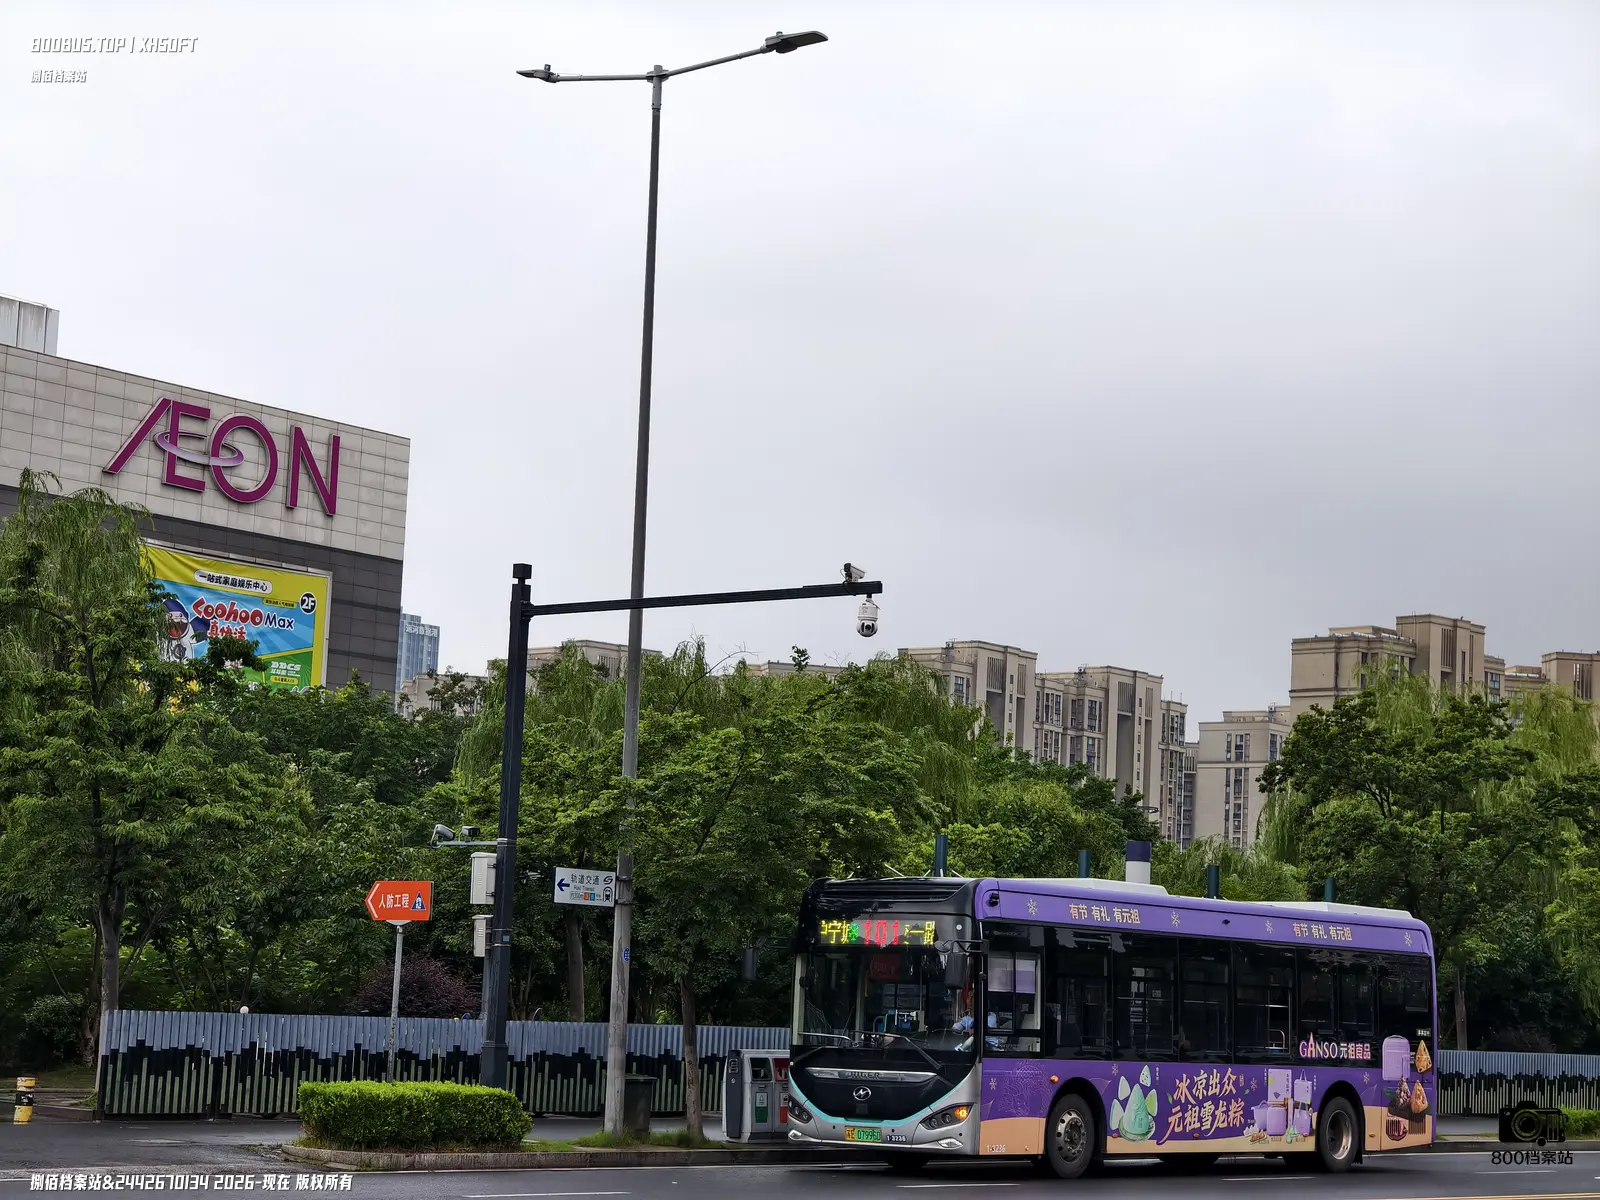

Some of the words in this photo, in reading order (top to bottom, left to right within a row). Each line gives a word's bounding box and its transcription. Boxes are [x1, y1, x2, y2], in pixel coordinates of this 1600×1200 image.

[198, 573, 268, 592] 一站式家庭娱乐中心
[301, 596, 315, 610] 2F
[264, 612, 294, 630] Max
[570, 873, 599, 886] 轨道交通
[378, 893, 409, 909] 人防工程
[1068, 903, 1088, 920] 有节
[1091, 905, 1110, 922] 有礼
[1113, 906, 1141, 924] 有元祖
[863, 919, 900, 945] 101
[1292, 922, 1309, 937] 有节
[1311, 924, 1328, 939] 有礼
[1329, 925, 1353, 941] 有元祖
[1299, 1032, 1338, 1059] GANSO
[1339, 1042, 1371, 1060] 元祖食品
[1173, 1067, 1237, 1104] 冰凉出众
[1156, 1098, 1245, 1145] 元祖雪龙粽
